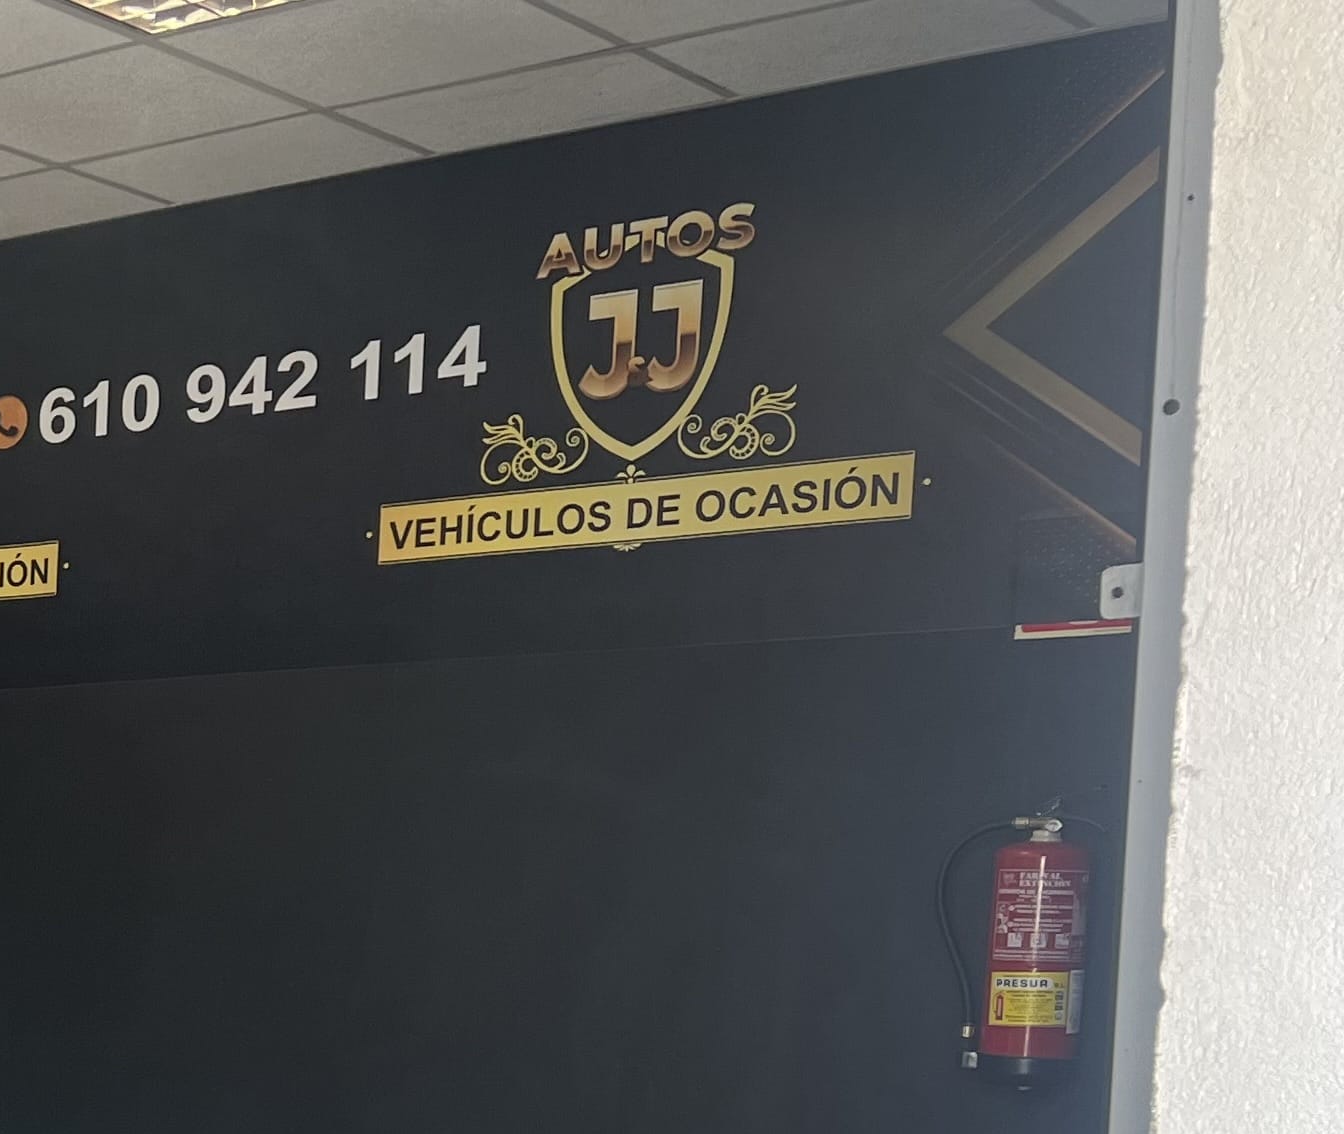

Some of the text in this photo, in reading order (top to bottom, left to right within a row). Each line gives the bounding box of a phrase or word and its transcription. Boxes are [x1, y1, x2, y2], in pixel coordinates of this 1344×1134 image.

[535, 202, 755, 280] AUTOS
[38, 324, 487, 444] 610 942 114
[389, 466, 900, 550] VEHÍCULOS DE OCASIÓN
